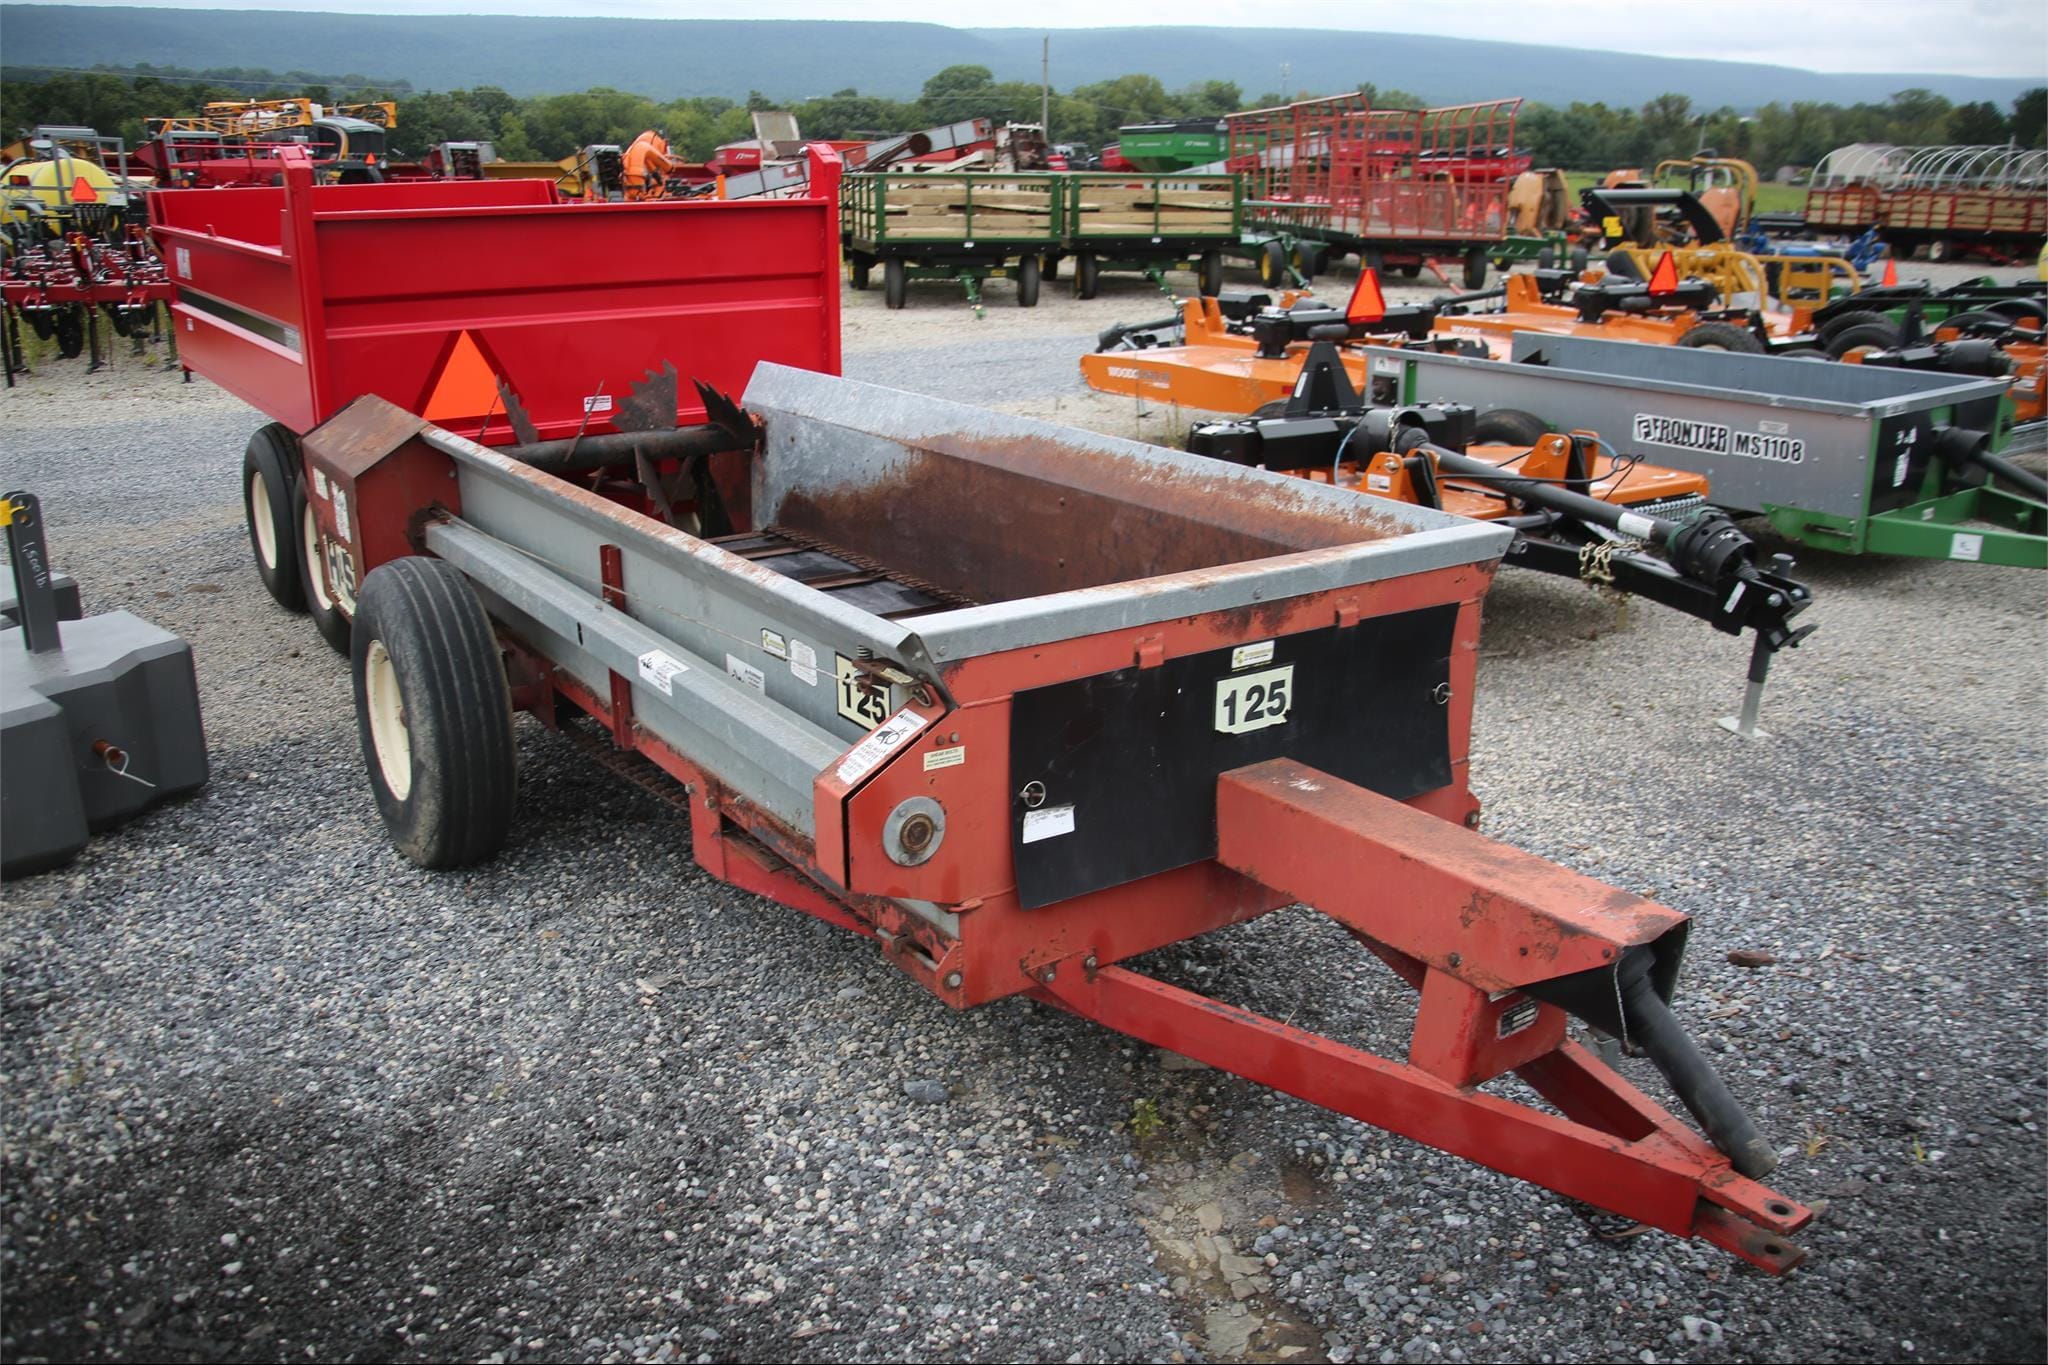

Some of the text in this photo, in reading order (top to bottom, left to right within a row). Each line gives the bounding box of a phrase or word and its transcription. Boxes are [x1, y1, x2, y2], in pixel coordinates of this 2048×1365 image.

[1653, 417, 1728, 453] FRONTIER
[1735, 433, 1803, 463] MS1108
[842, 672, 886, 725] 125
[1223, 679, 1287, 727] 125
